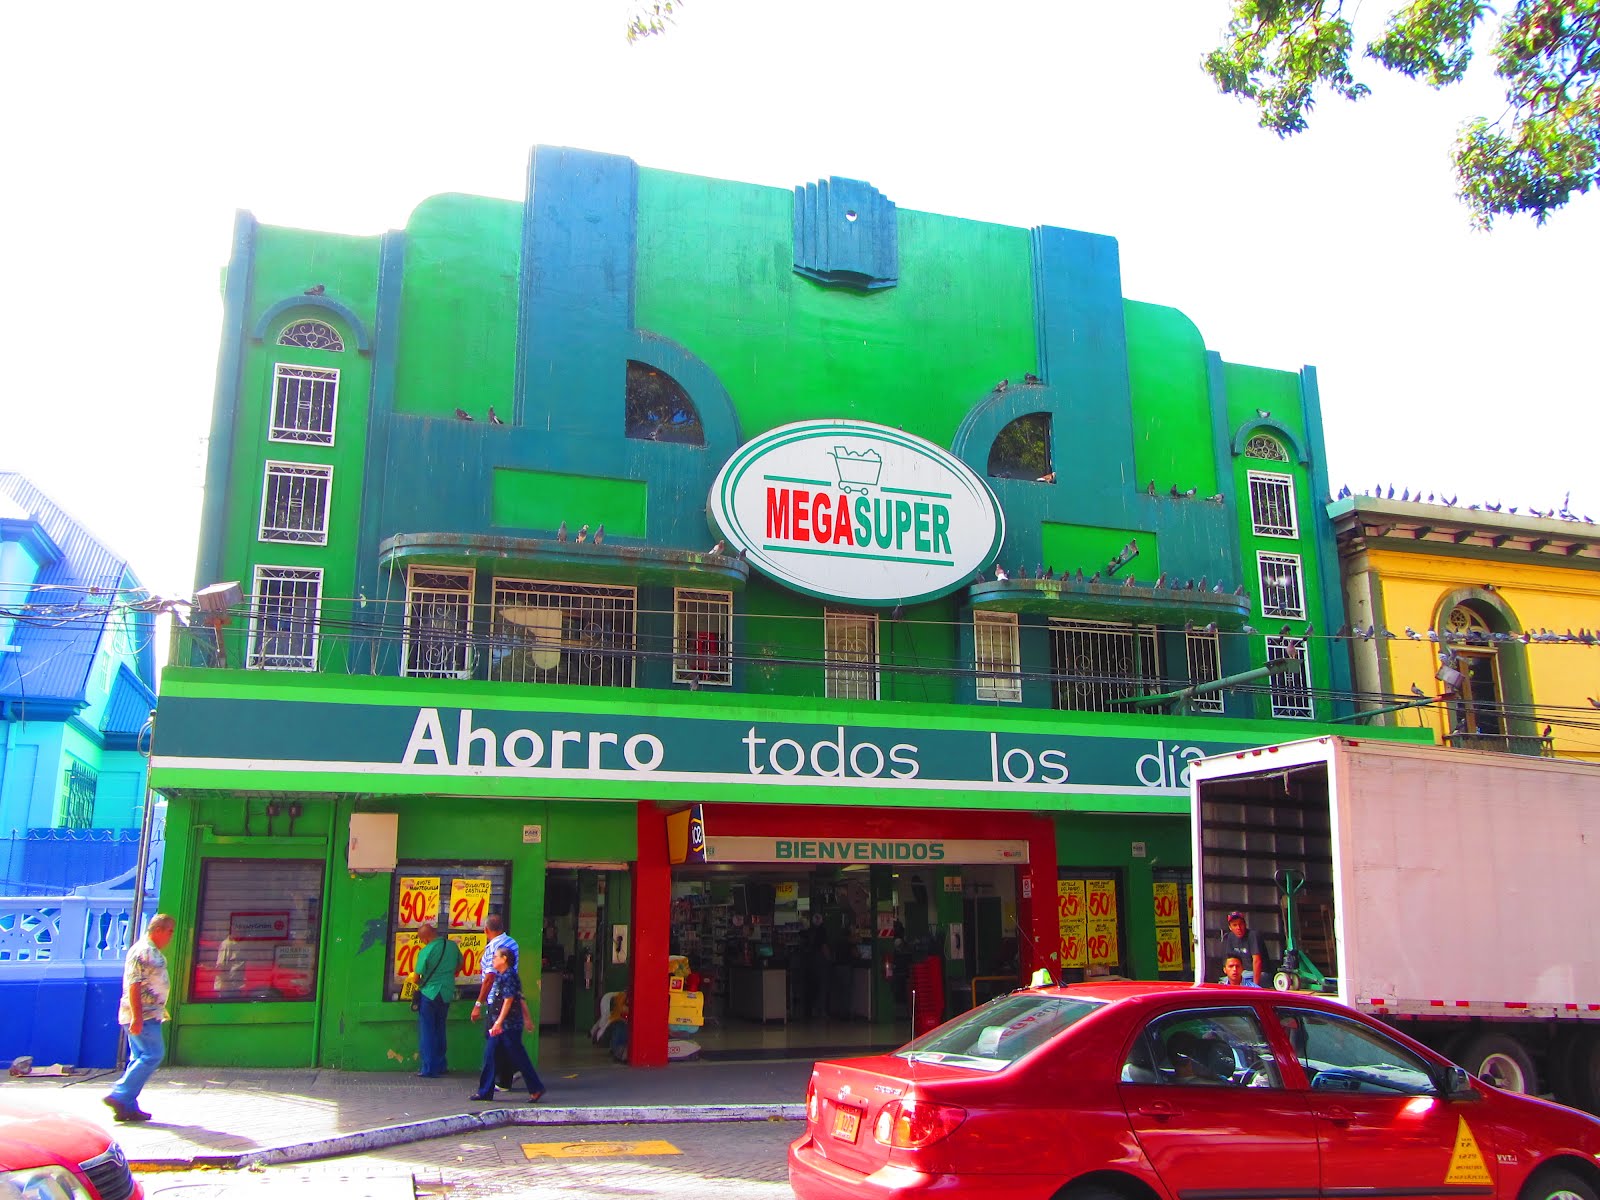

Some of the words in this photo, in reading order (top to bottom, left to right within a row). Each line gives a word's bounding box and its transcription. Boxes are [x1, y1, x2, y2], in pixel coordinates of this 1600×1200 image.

[766, 487, 952, 554] MEGASUPER
[401, 707, 664, 772] Ahorro
[742, 726, 920, 779] todos
[990, 733, 1069, 785] los
[775, 841, 945, 861] BIENVENIDOS
